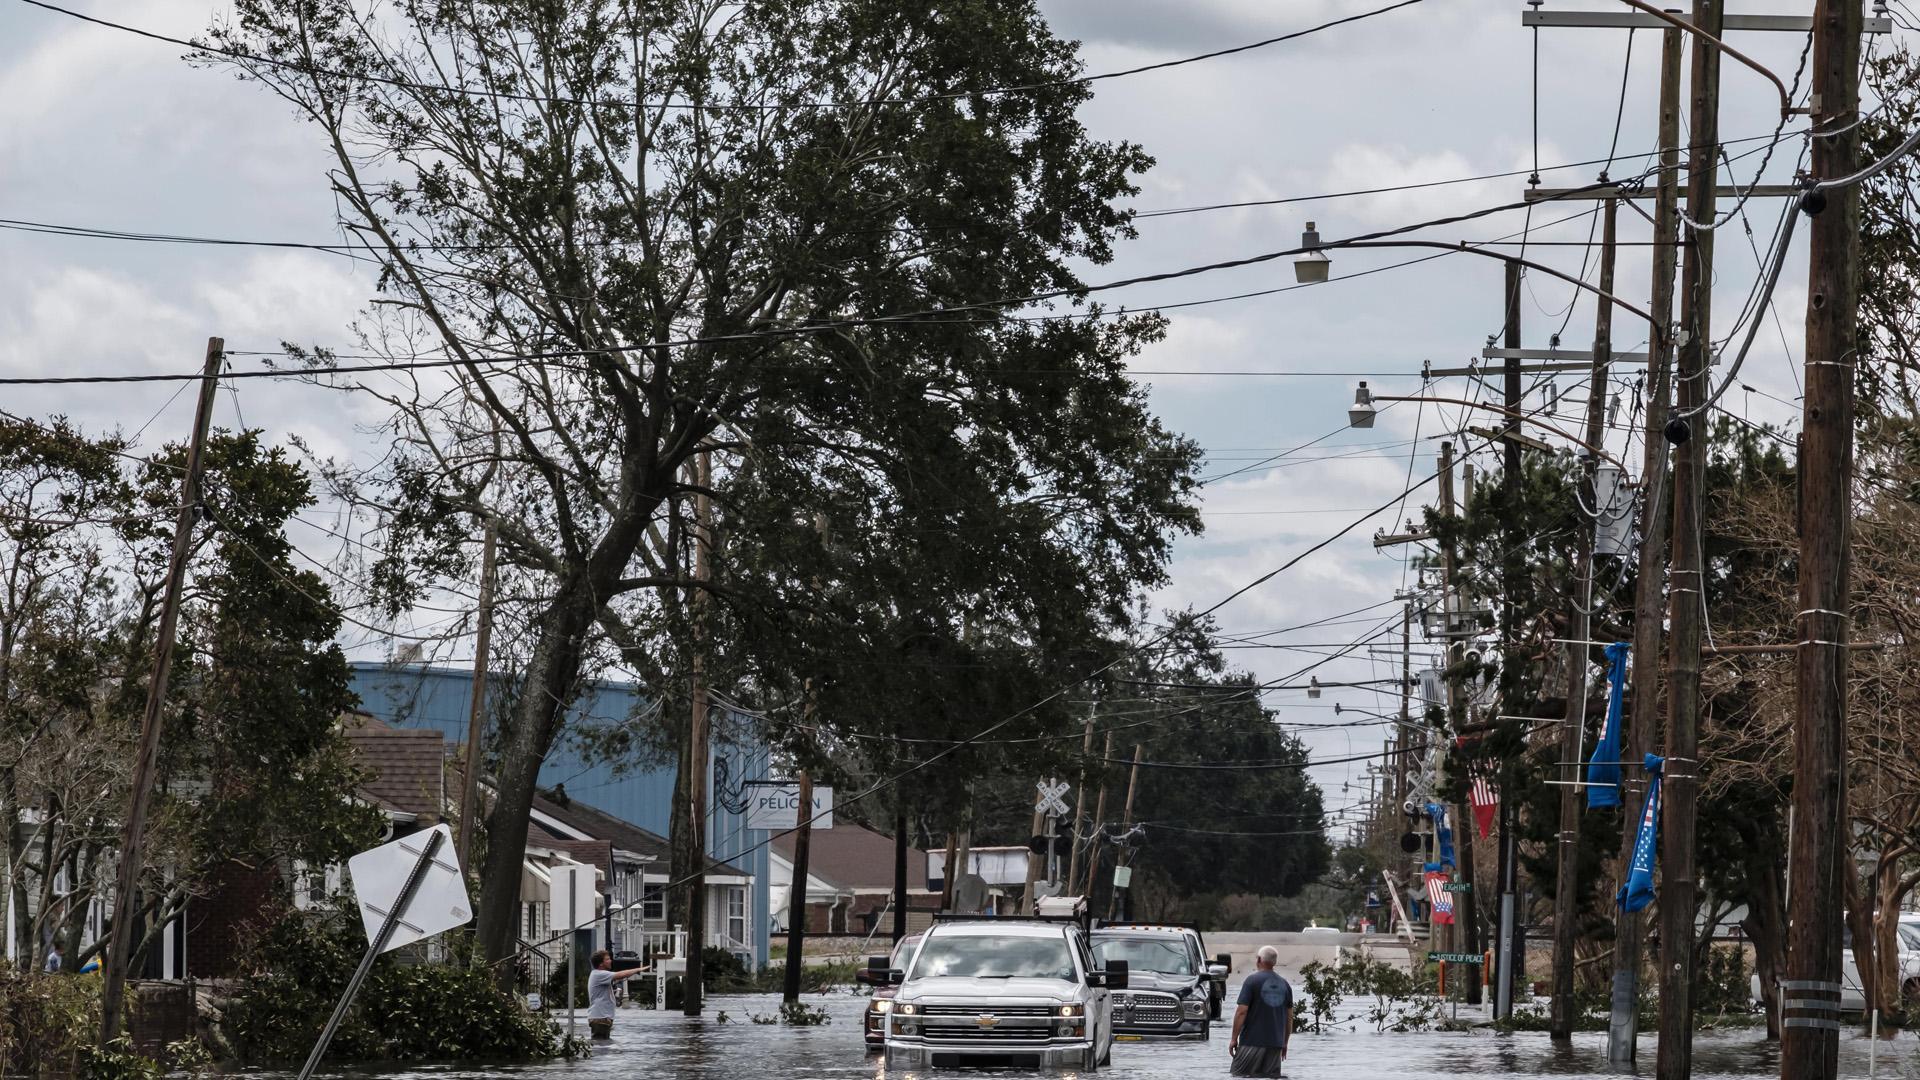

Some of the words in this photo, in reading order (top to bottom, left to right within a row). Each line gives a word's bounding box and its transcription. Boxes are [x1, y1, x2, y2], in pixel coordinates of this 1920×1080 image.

[759, 797, 821, 809] PELICN
[1036, 783, 1067, 811] CROSSING
[1038, 783, 1050, 797] RAIL
[1052, 798, 1065, 812] ROAD
[1436, 953, 1457, 962] JUSTICE
[1457, 954, 1464, 962] OF
[1465, 954, 1484, 963] PEACE
